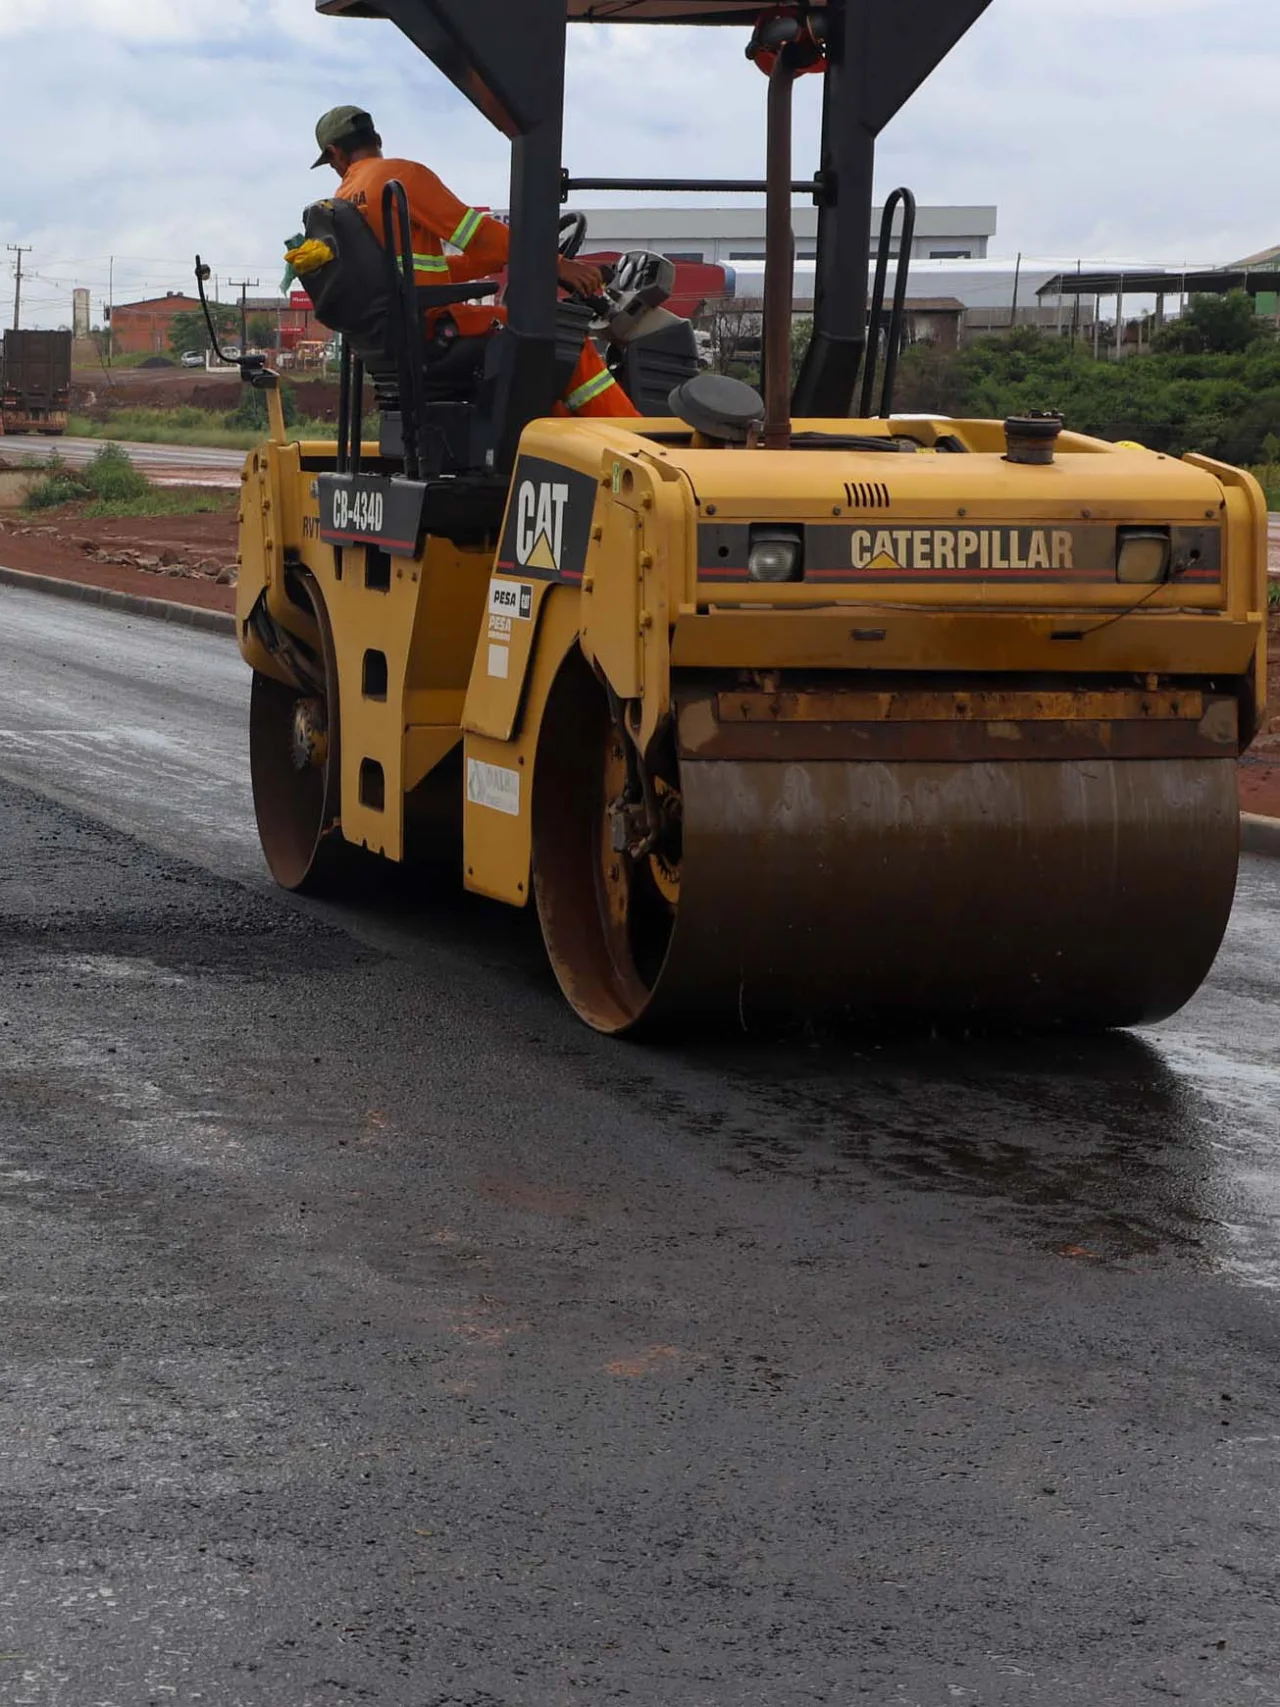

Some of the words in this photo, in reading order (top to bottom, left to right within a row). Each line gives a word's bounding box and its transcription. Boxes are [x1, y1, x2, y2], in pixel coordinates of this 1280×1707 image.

[333, 489, 383, 532] CB-434D
[516, 480, 569, 569] CAT
[851, 529, 1073, 569] CATERPILLAR
[493, 590, 516, 607] PESA
